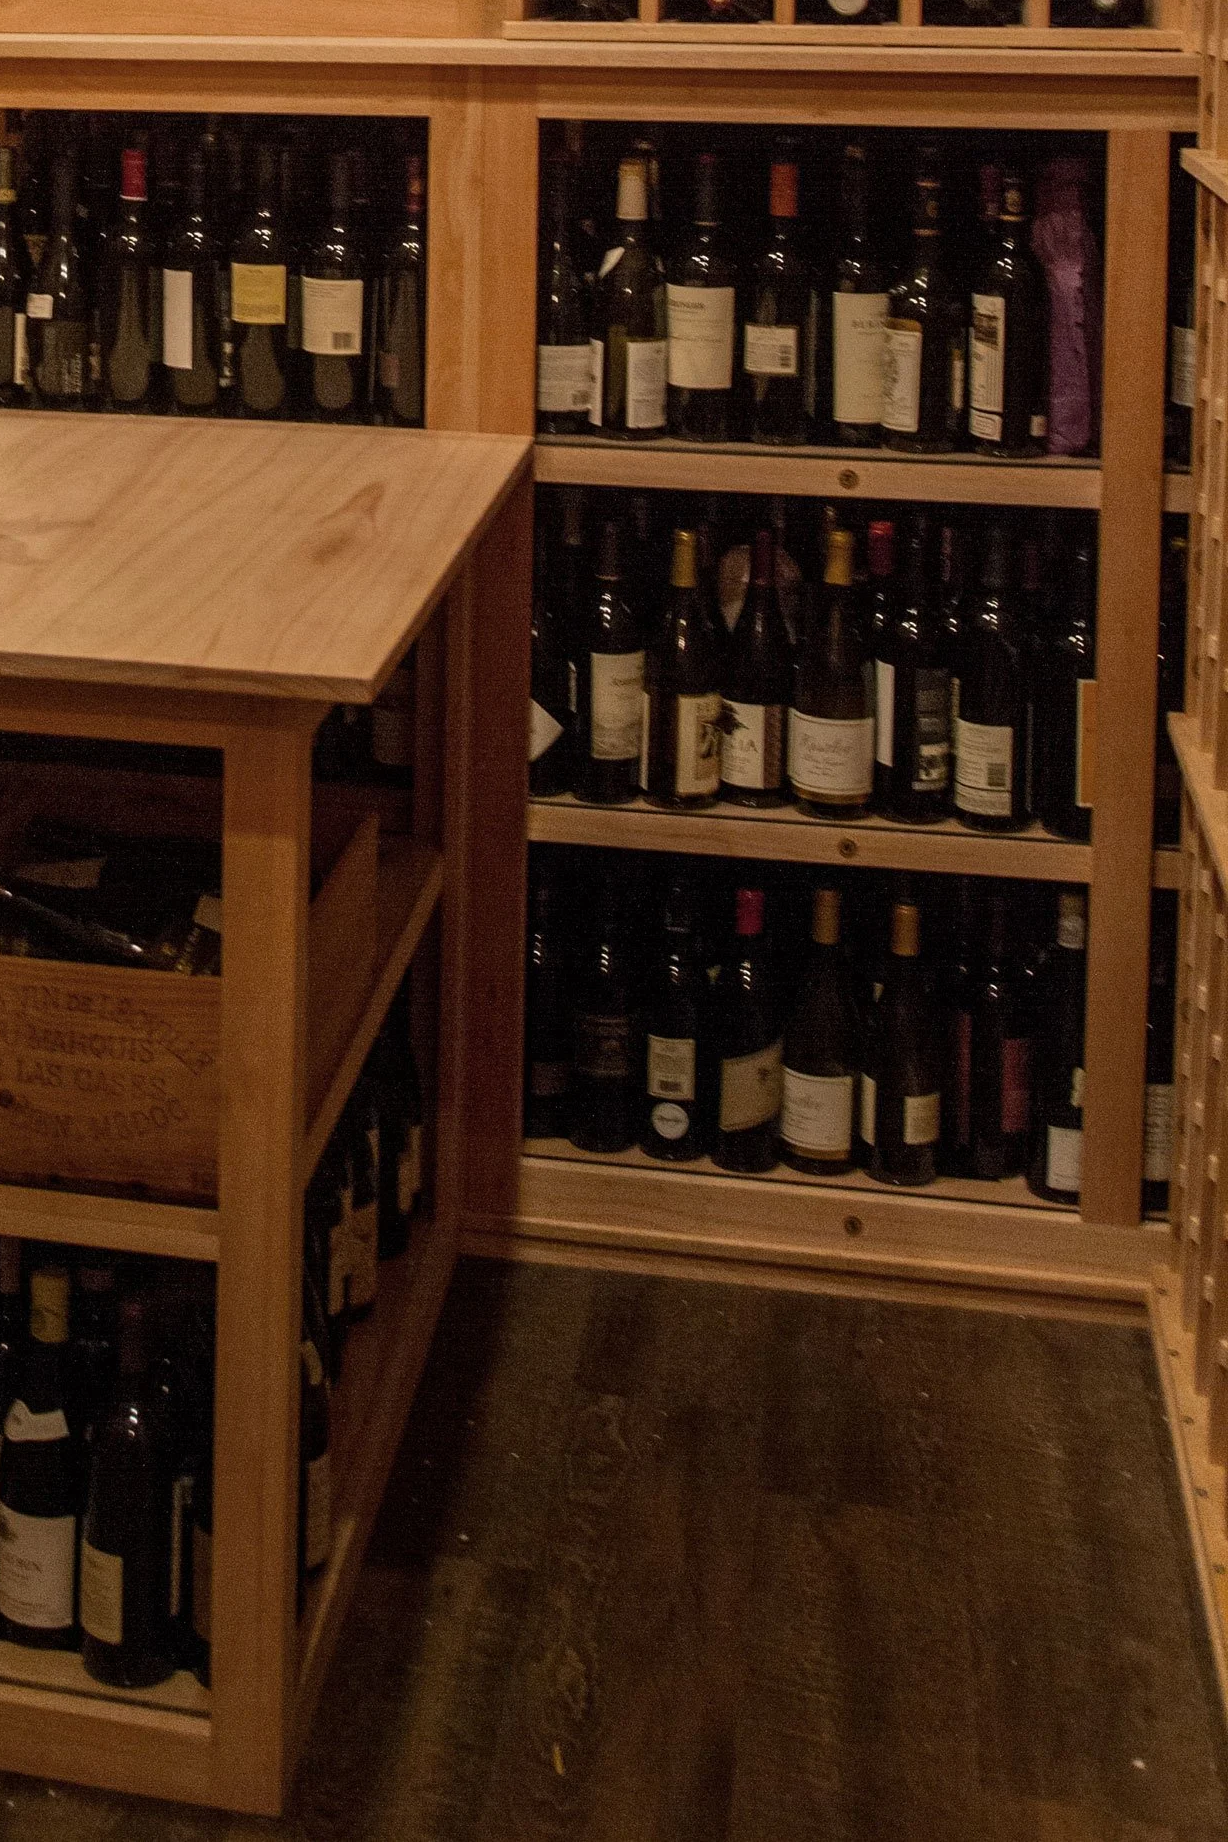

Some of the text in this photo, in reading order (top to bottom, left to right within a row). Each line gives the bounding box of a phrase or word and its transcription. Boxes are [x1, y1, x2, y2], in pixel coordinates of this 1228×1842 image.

[26, 1023, 157, 1065] MARQUIS
[16, 1057, 63, 1088] LAS
[73, 1066, 169, 1101] CASES
